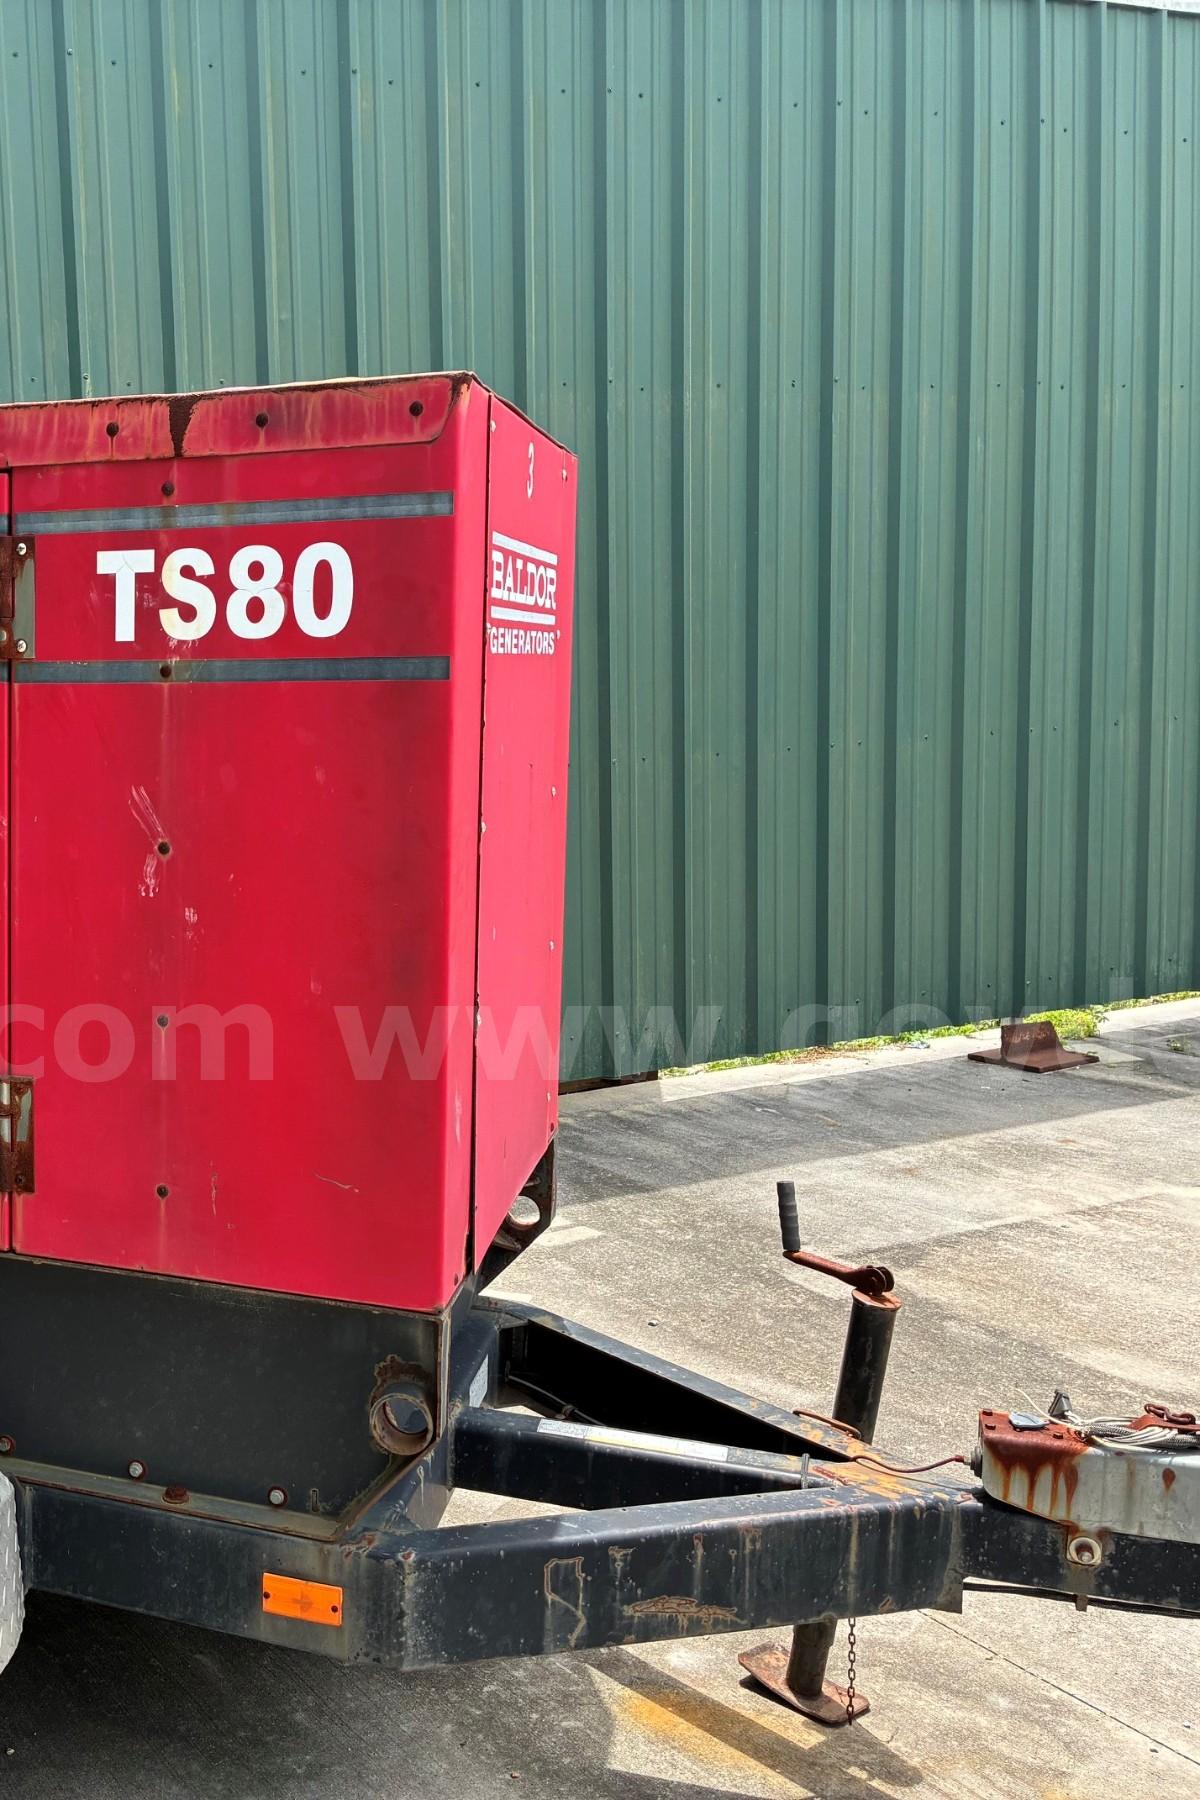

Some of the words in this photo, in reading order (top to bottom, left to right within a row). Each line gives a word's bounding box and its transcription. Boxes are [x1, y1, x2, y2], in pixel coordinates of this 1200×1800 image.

[526, 441, 536, 499] 3
[96, 541, 354, 645] TS80
[490, 549, 557, 611] BALDOR
[488, 626, 555, 655] GENERATORS
